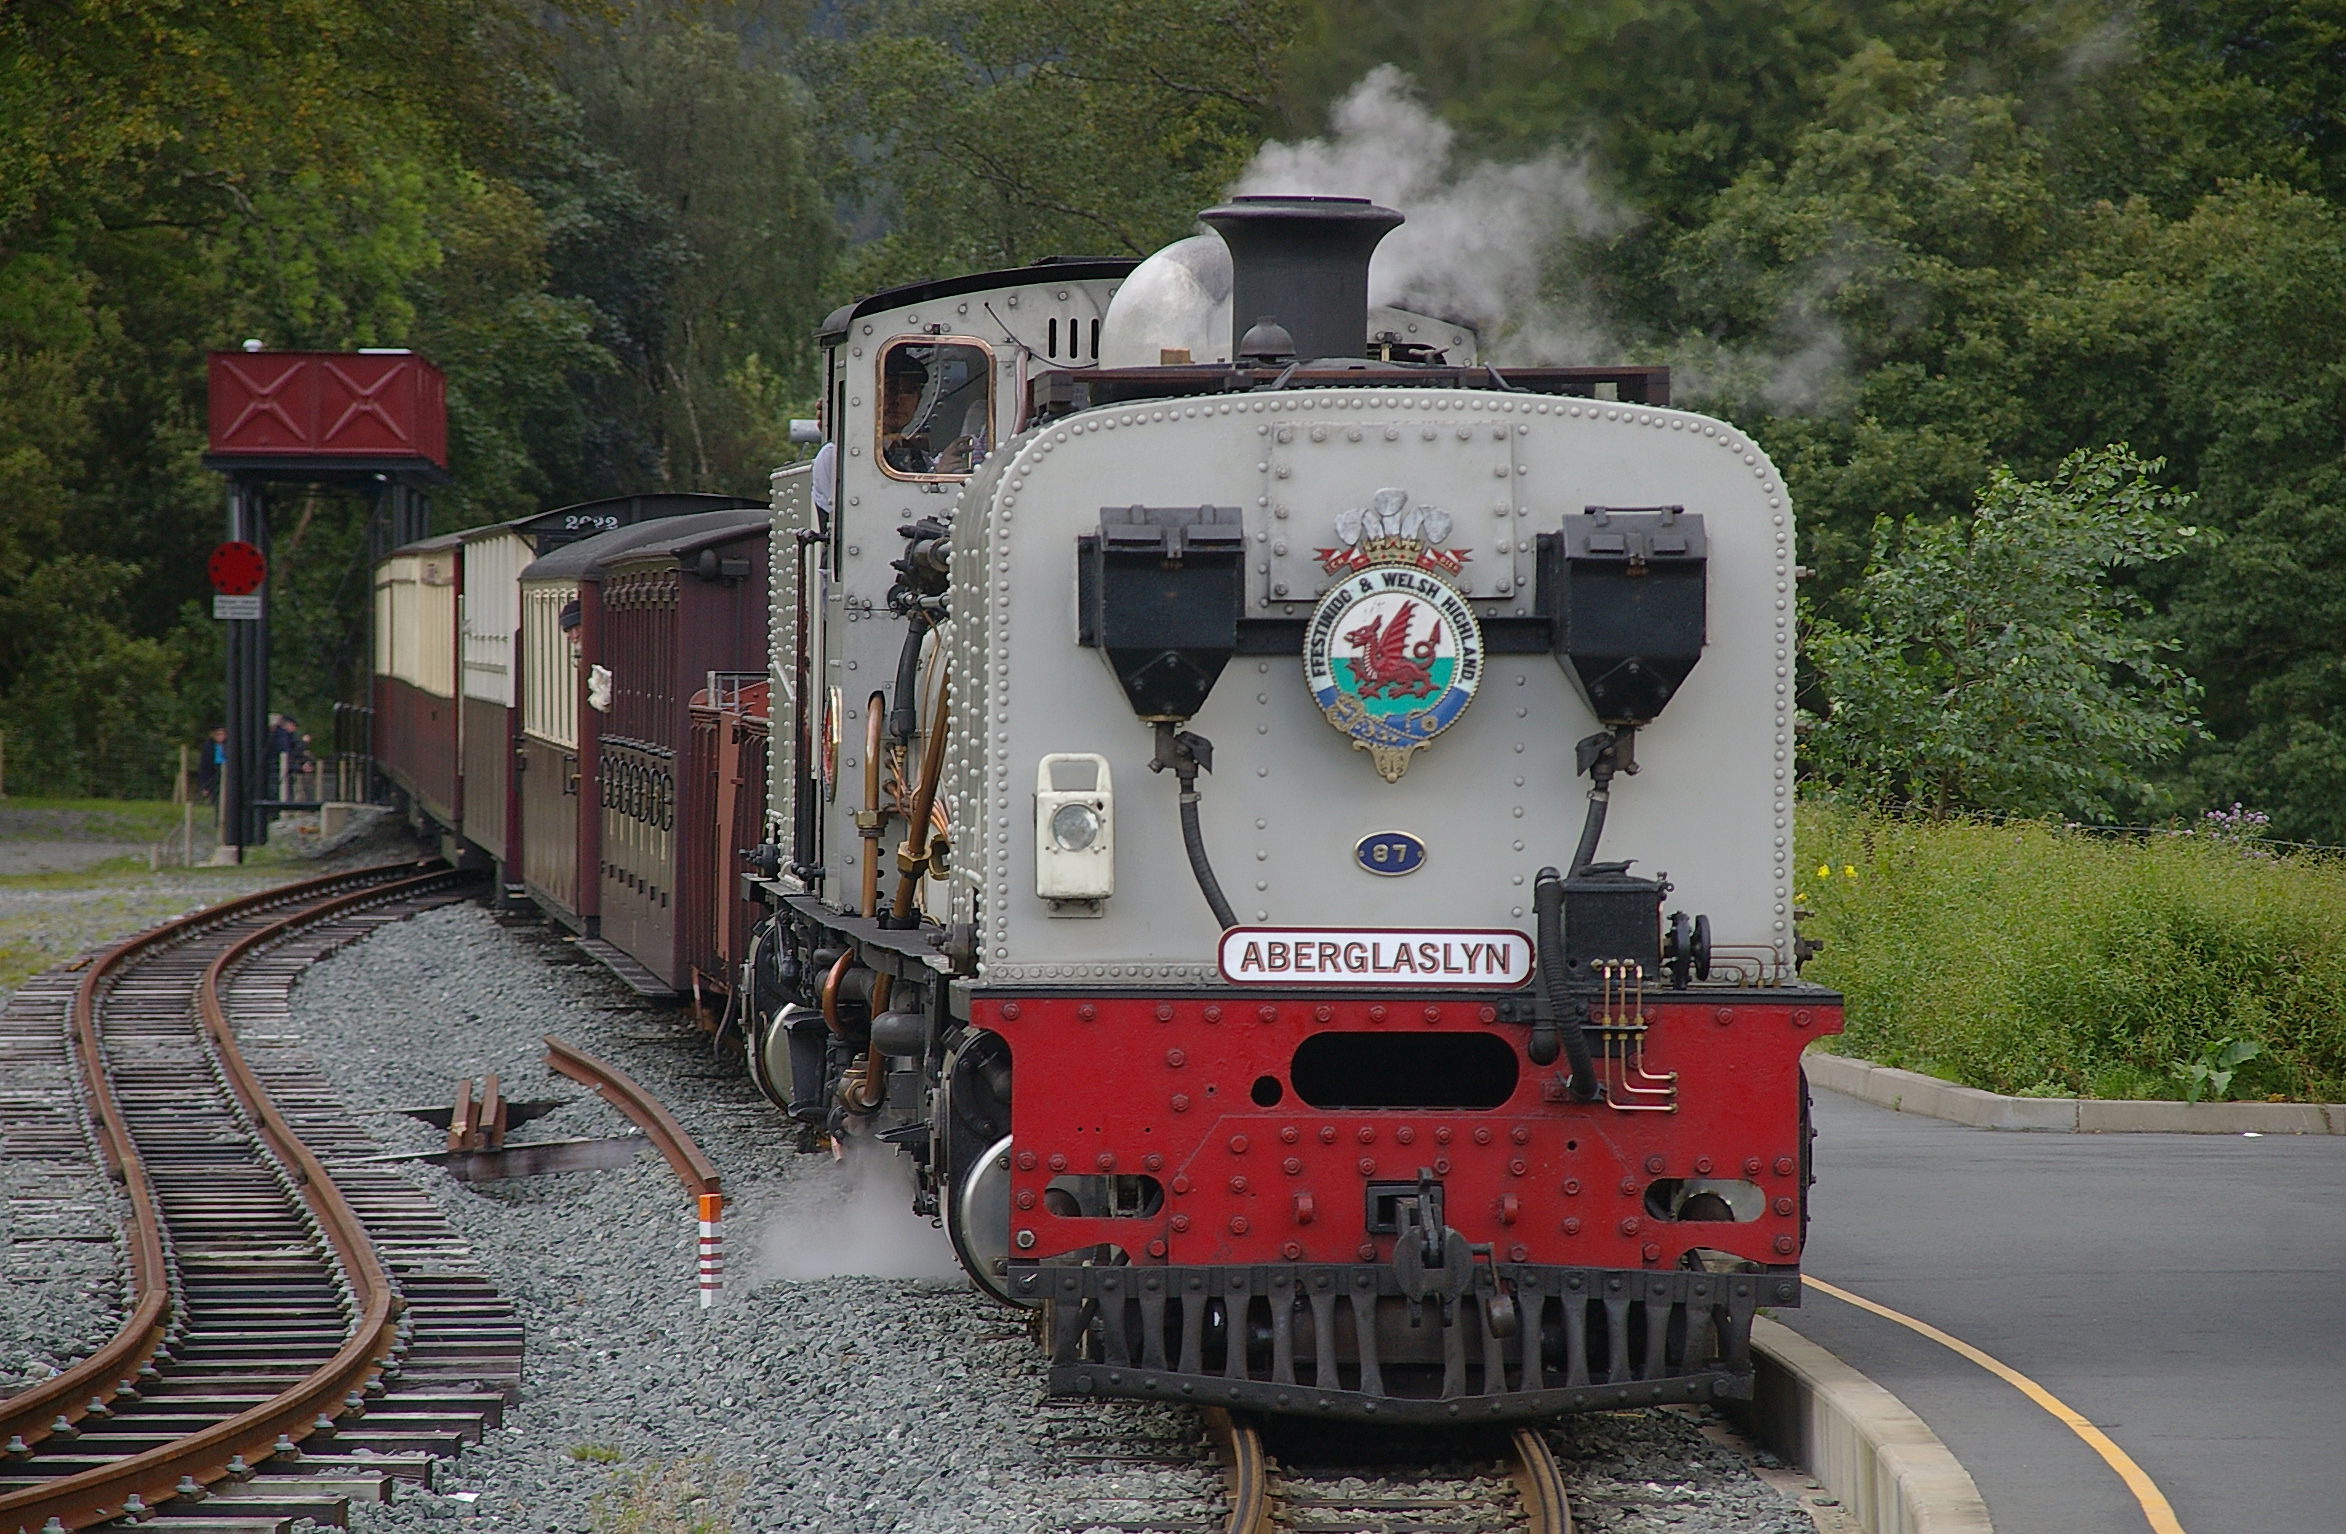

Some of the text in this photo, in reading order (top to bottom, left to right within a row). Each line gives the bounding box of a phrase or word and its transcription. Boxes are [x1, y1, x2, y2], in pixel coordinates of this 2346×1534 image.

[1310, 588, 1353, 678] FFESTINIOG
[1359, 577, 1374, 593] &
[1381, 572, 1442, 599] WELSH
[1372, 844, 1408, 863] 87
[1240, 941, 1511, 975] ABERGLASLYN
